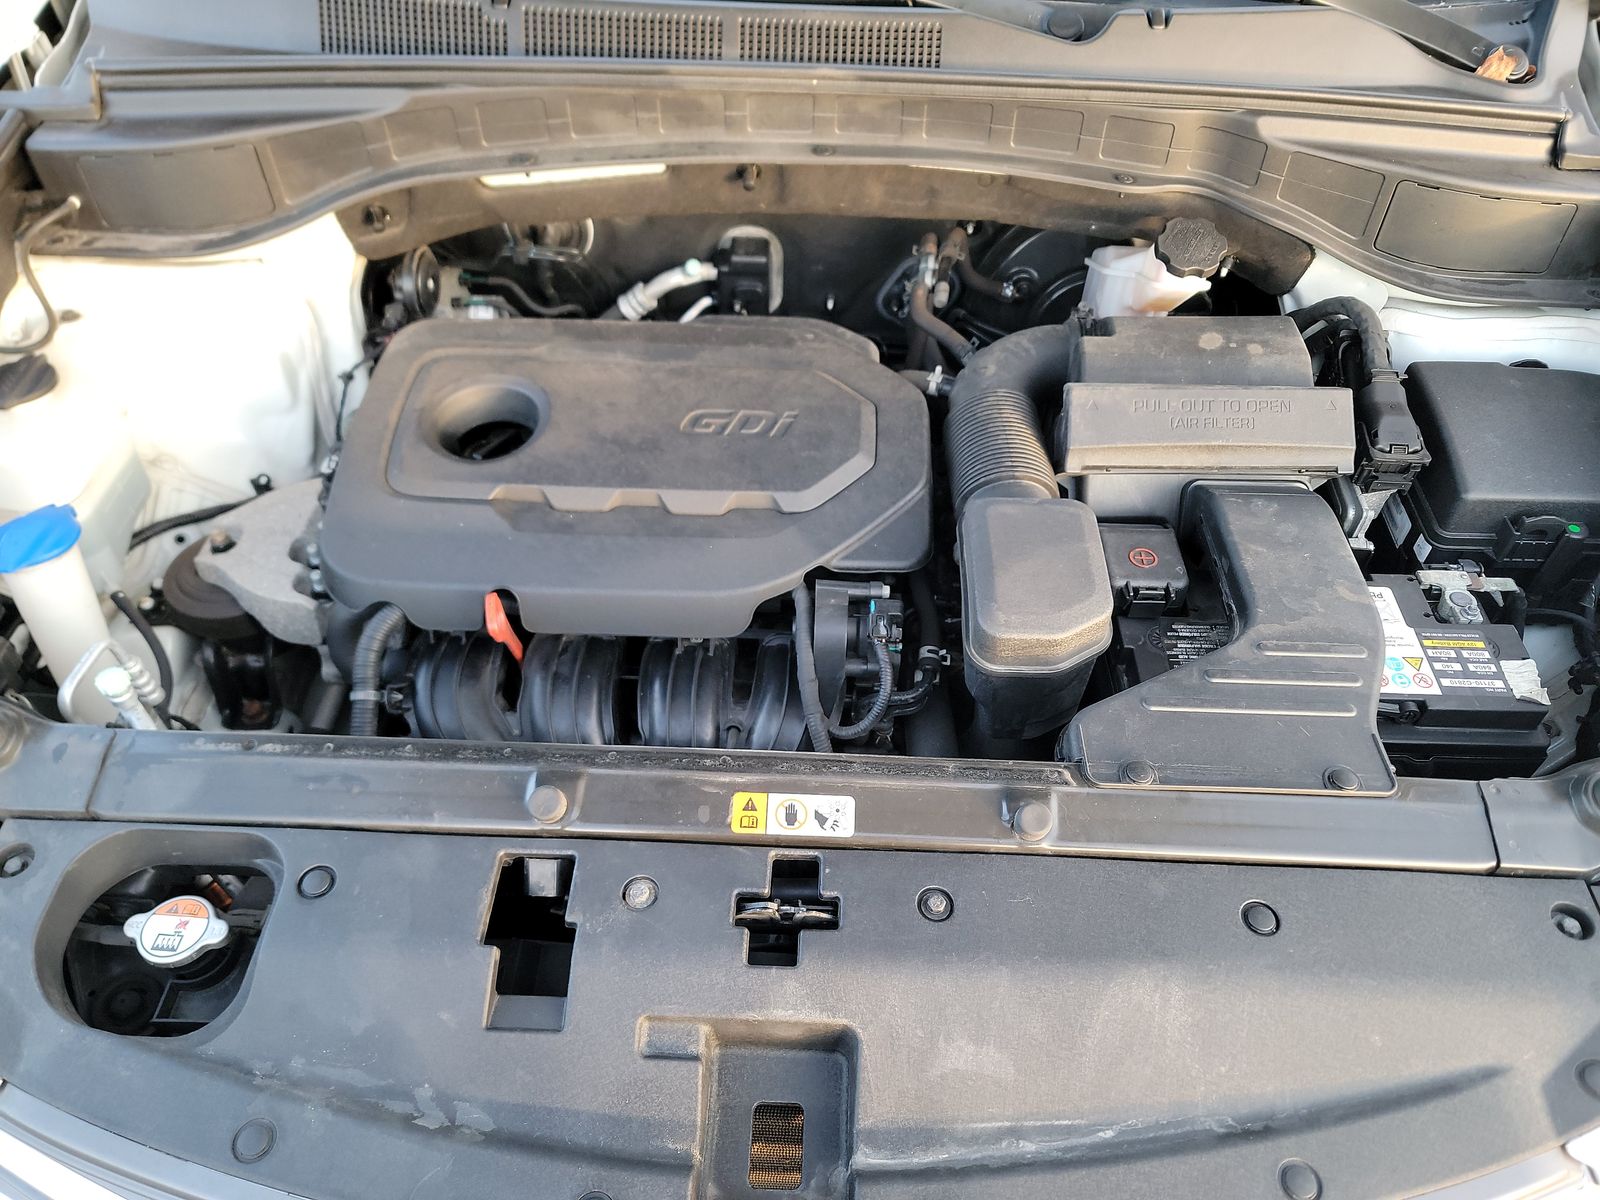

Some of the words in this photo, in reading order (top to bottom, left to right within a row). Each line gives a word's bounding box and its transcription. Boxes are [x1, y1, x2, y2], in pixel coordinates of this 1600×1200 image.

[1133, 399, 1177, 413] PULL
[1180, 399, 1215, 413] OUT
[1221, 399, 1245, 413] TO
[1246, 399, 1292, 414] OPEN
